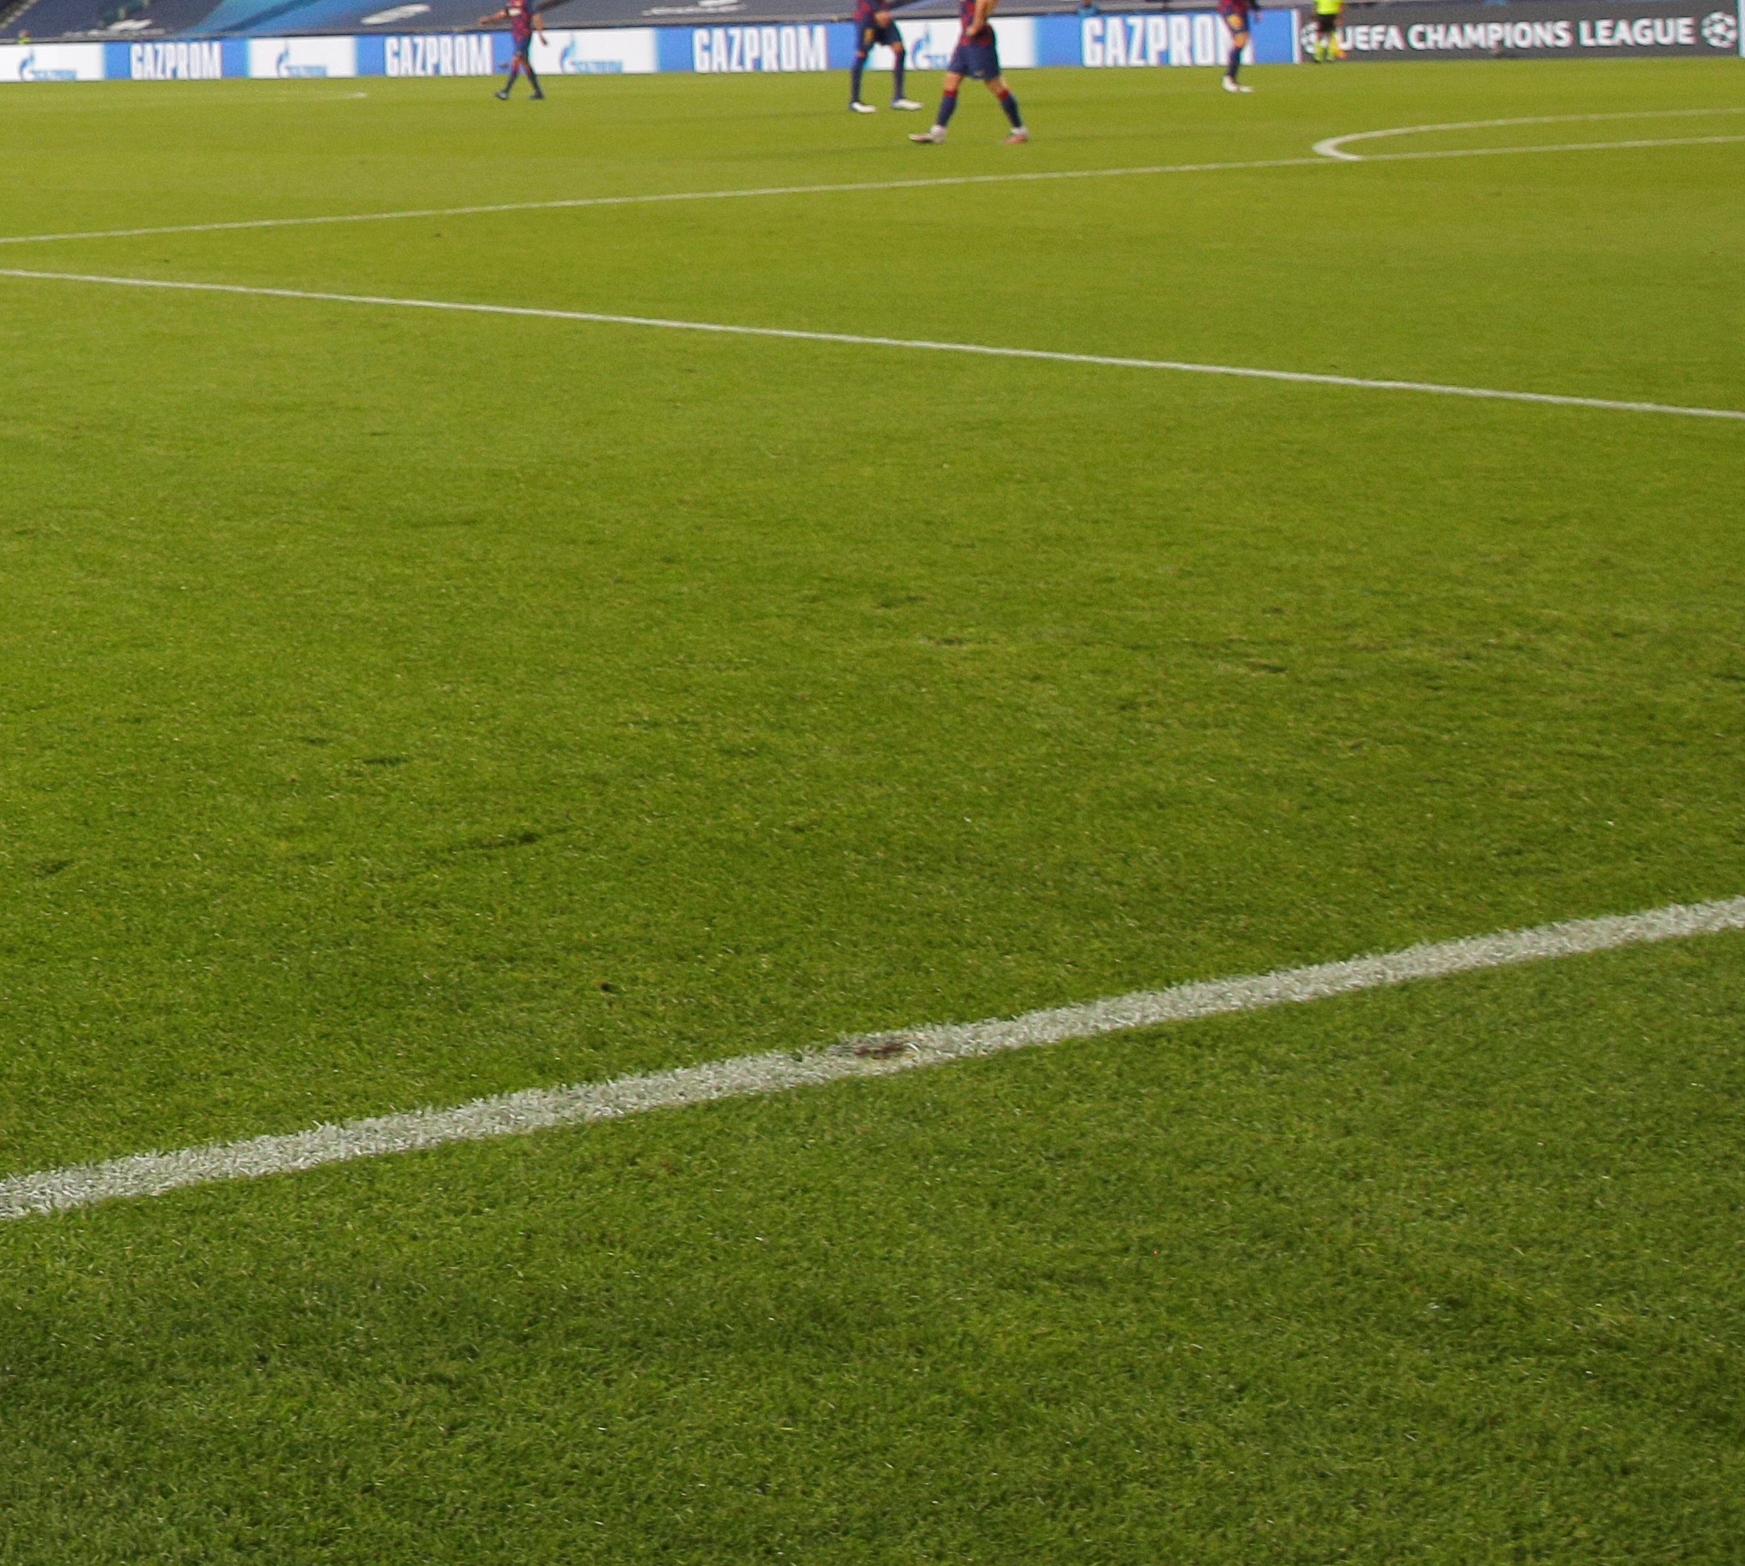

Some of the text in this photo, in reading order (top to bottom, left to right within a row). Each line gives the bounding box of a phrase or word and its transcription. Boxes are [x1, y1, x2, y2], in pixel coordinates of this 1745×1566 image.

[692, 24, 828, 72] GAZPROM
[1338, 16, 1696, 51] UEFA CHAMPIONS LEAGUE
[129, 41, 223, 80] GAZPROM
[383, 34, 492, 77] GAZPROM
